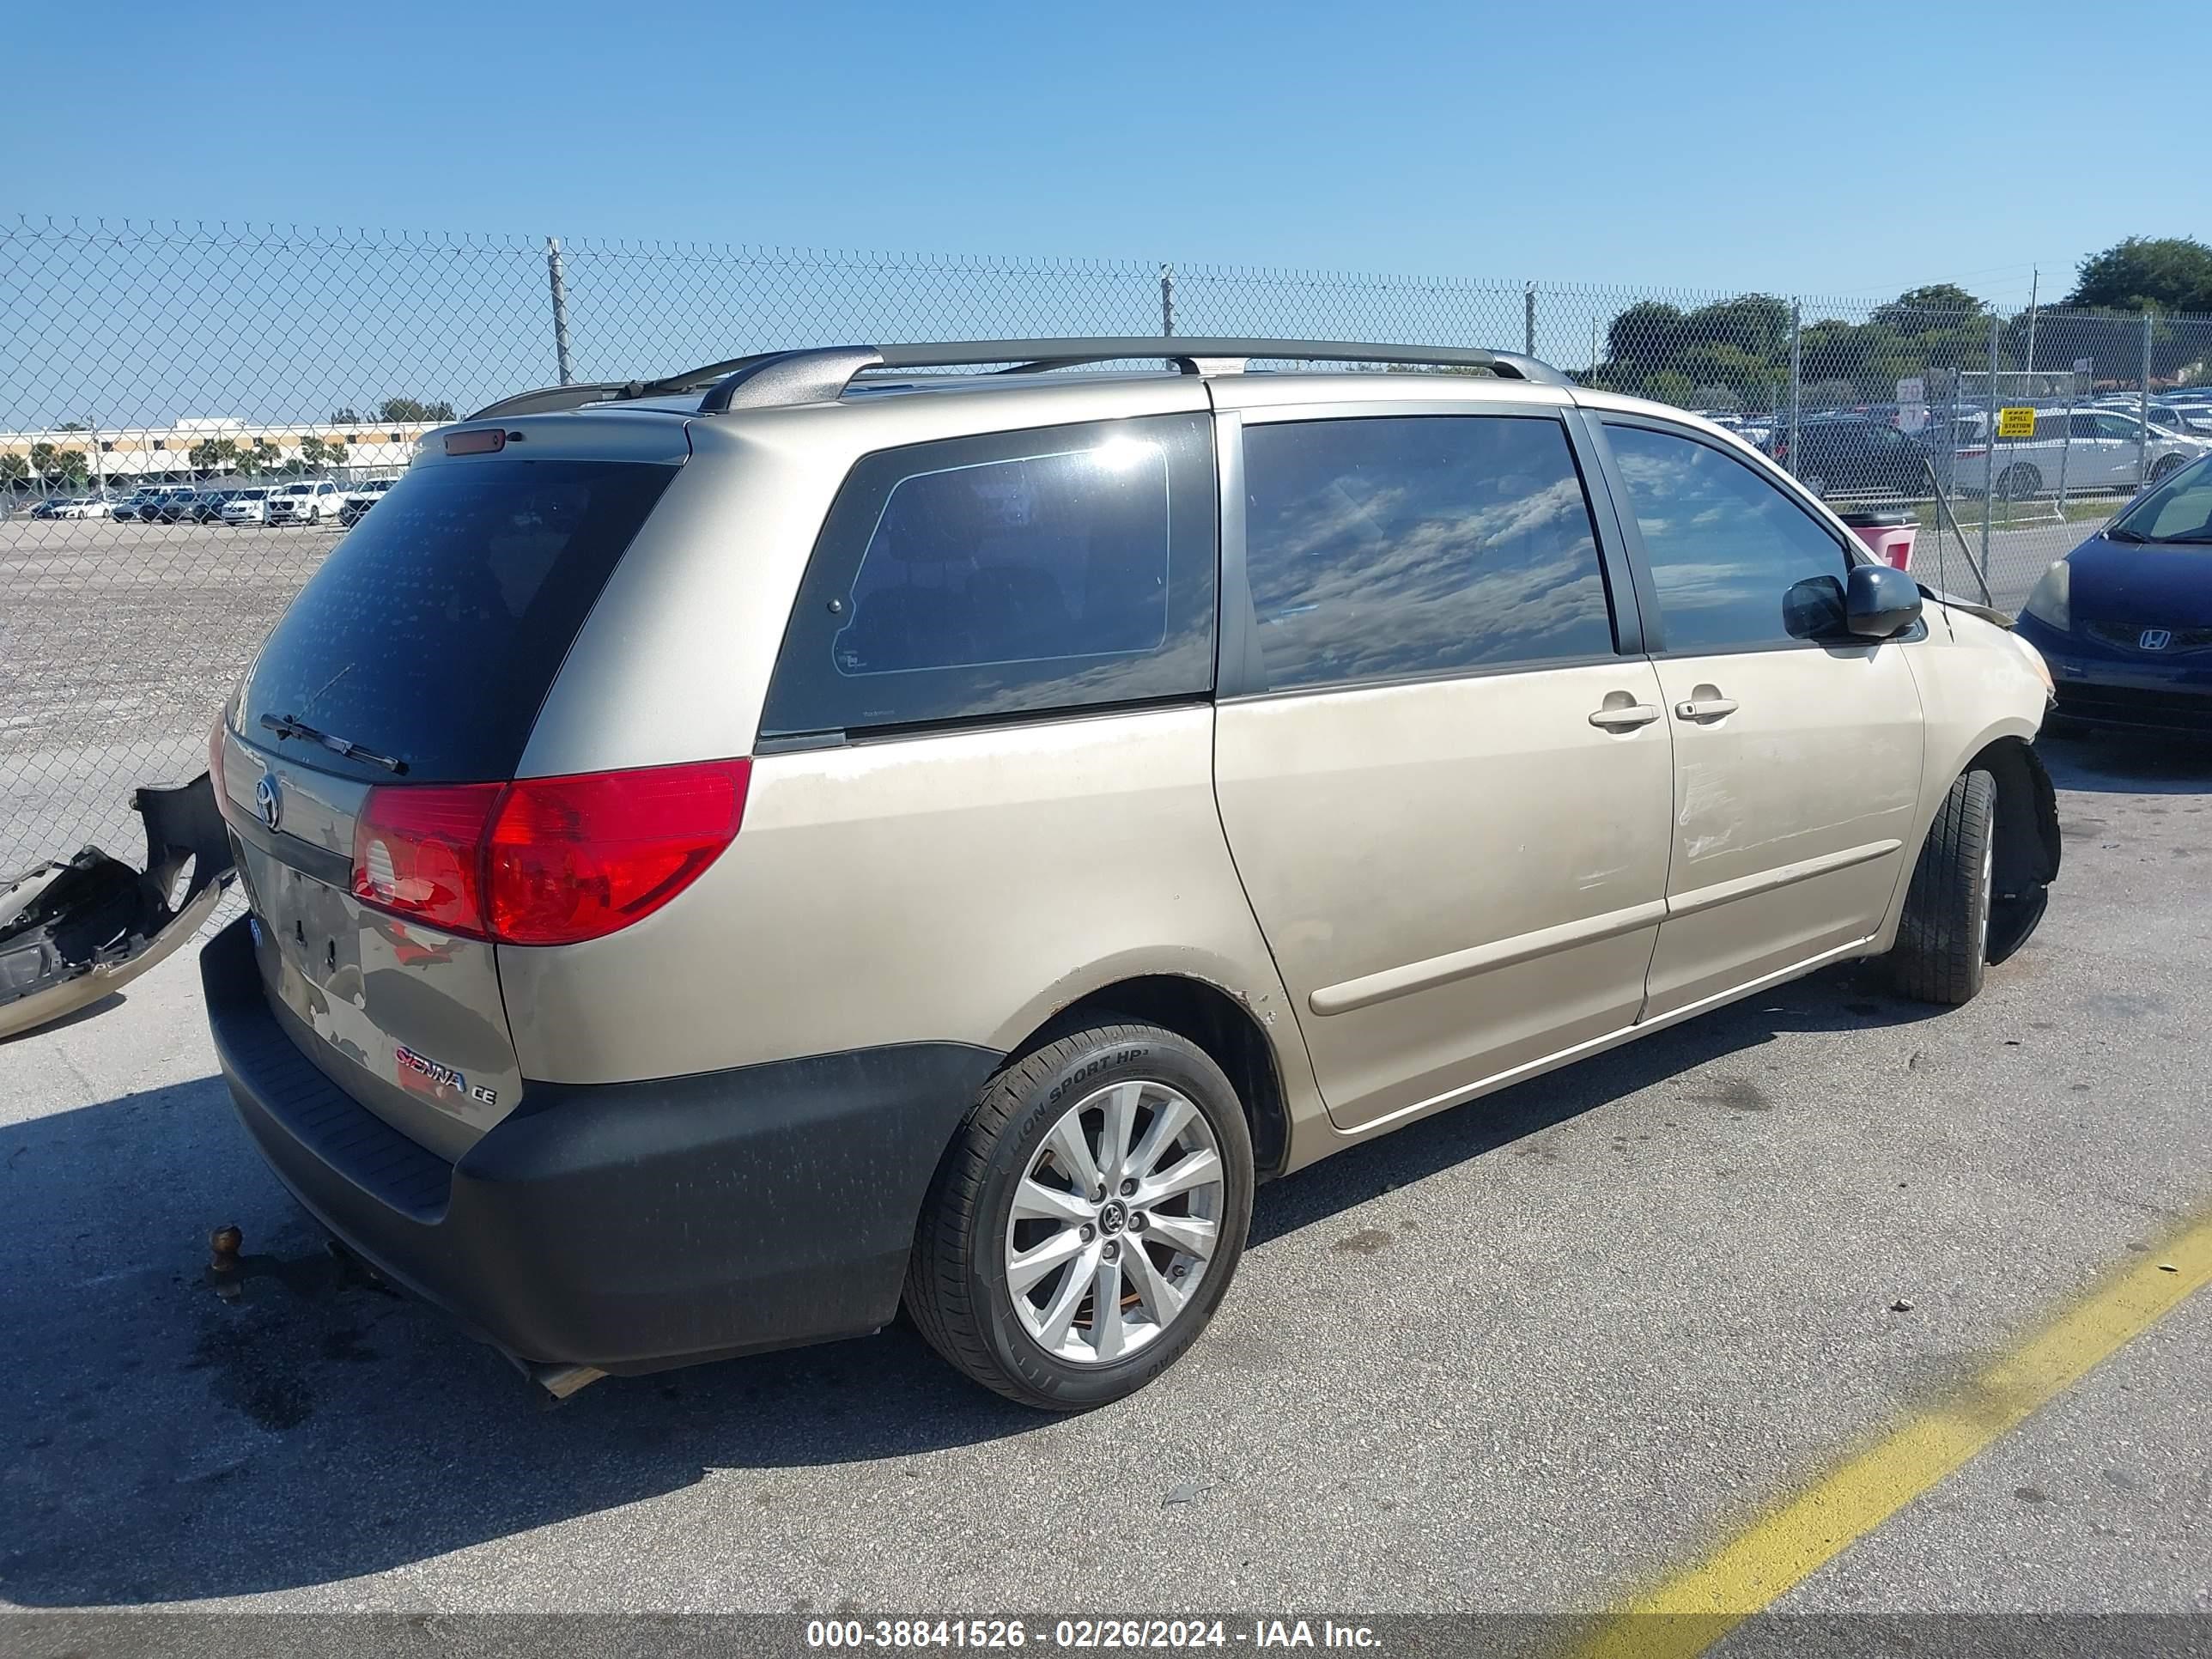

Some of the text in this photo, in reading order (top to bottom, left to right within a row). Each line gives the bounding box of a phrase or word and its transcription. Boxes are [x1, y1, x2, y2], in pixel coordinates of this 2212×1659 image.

[395, 1046, 497, 1105] SIENNA CE
[1049, 1055, 1110, 1104] SPORT
